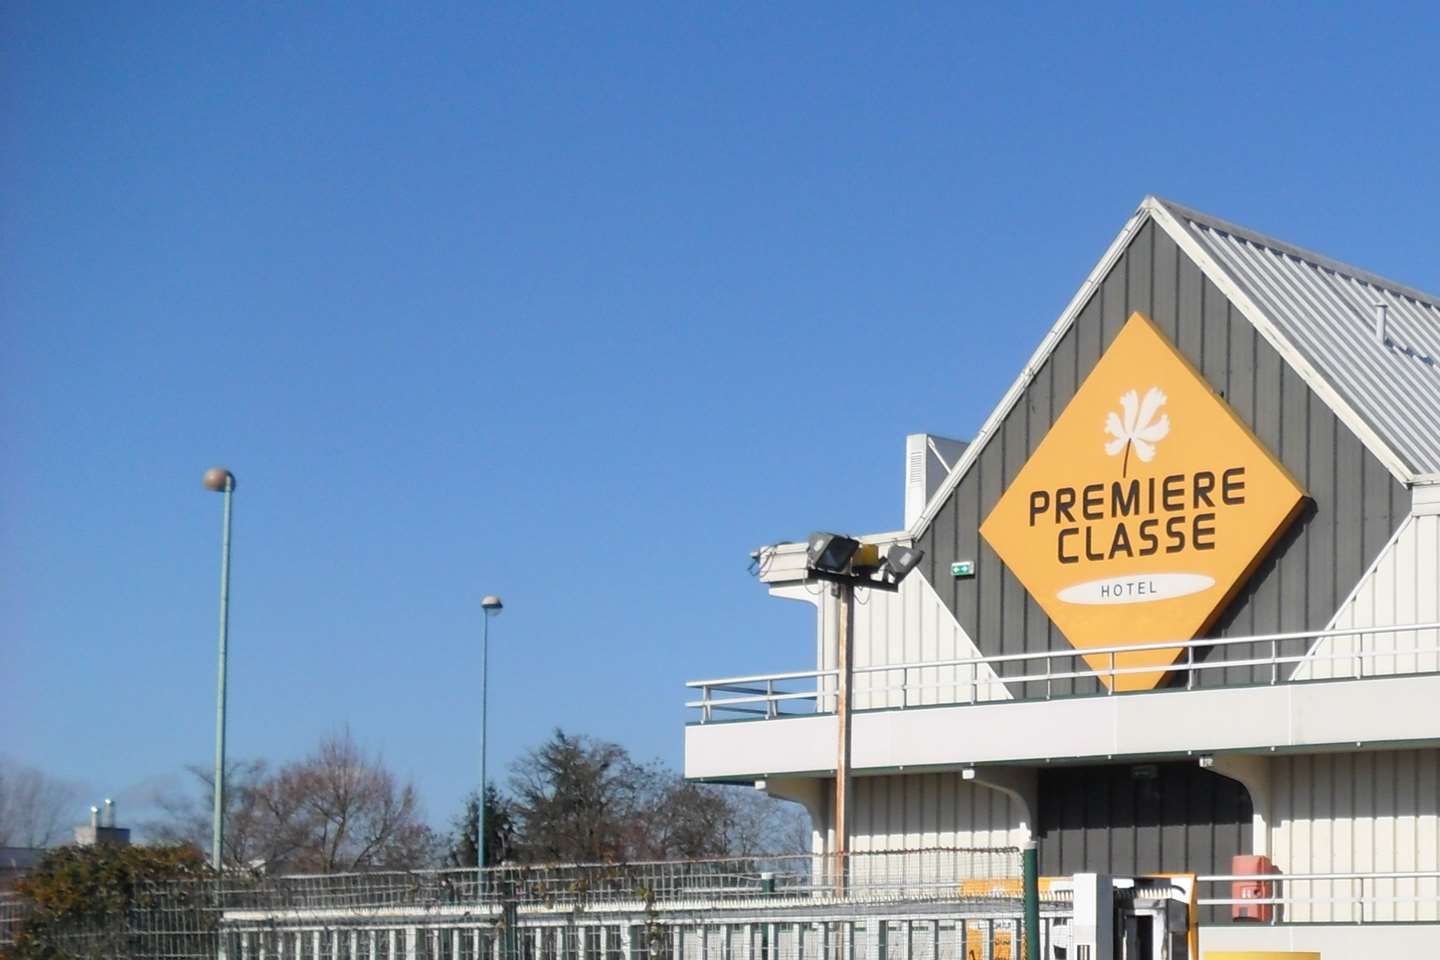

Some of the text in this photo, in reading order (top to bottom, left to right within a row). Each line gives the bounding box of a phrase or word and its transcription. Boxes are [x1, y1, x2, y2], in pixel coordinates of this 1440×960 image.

[1029, 466, 1246, 527] PREMIERE
[1057, 512, 1216, 565] CLASSE
[1100, 581, 1158, 598] HOTEL
